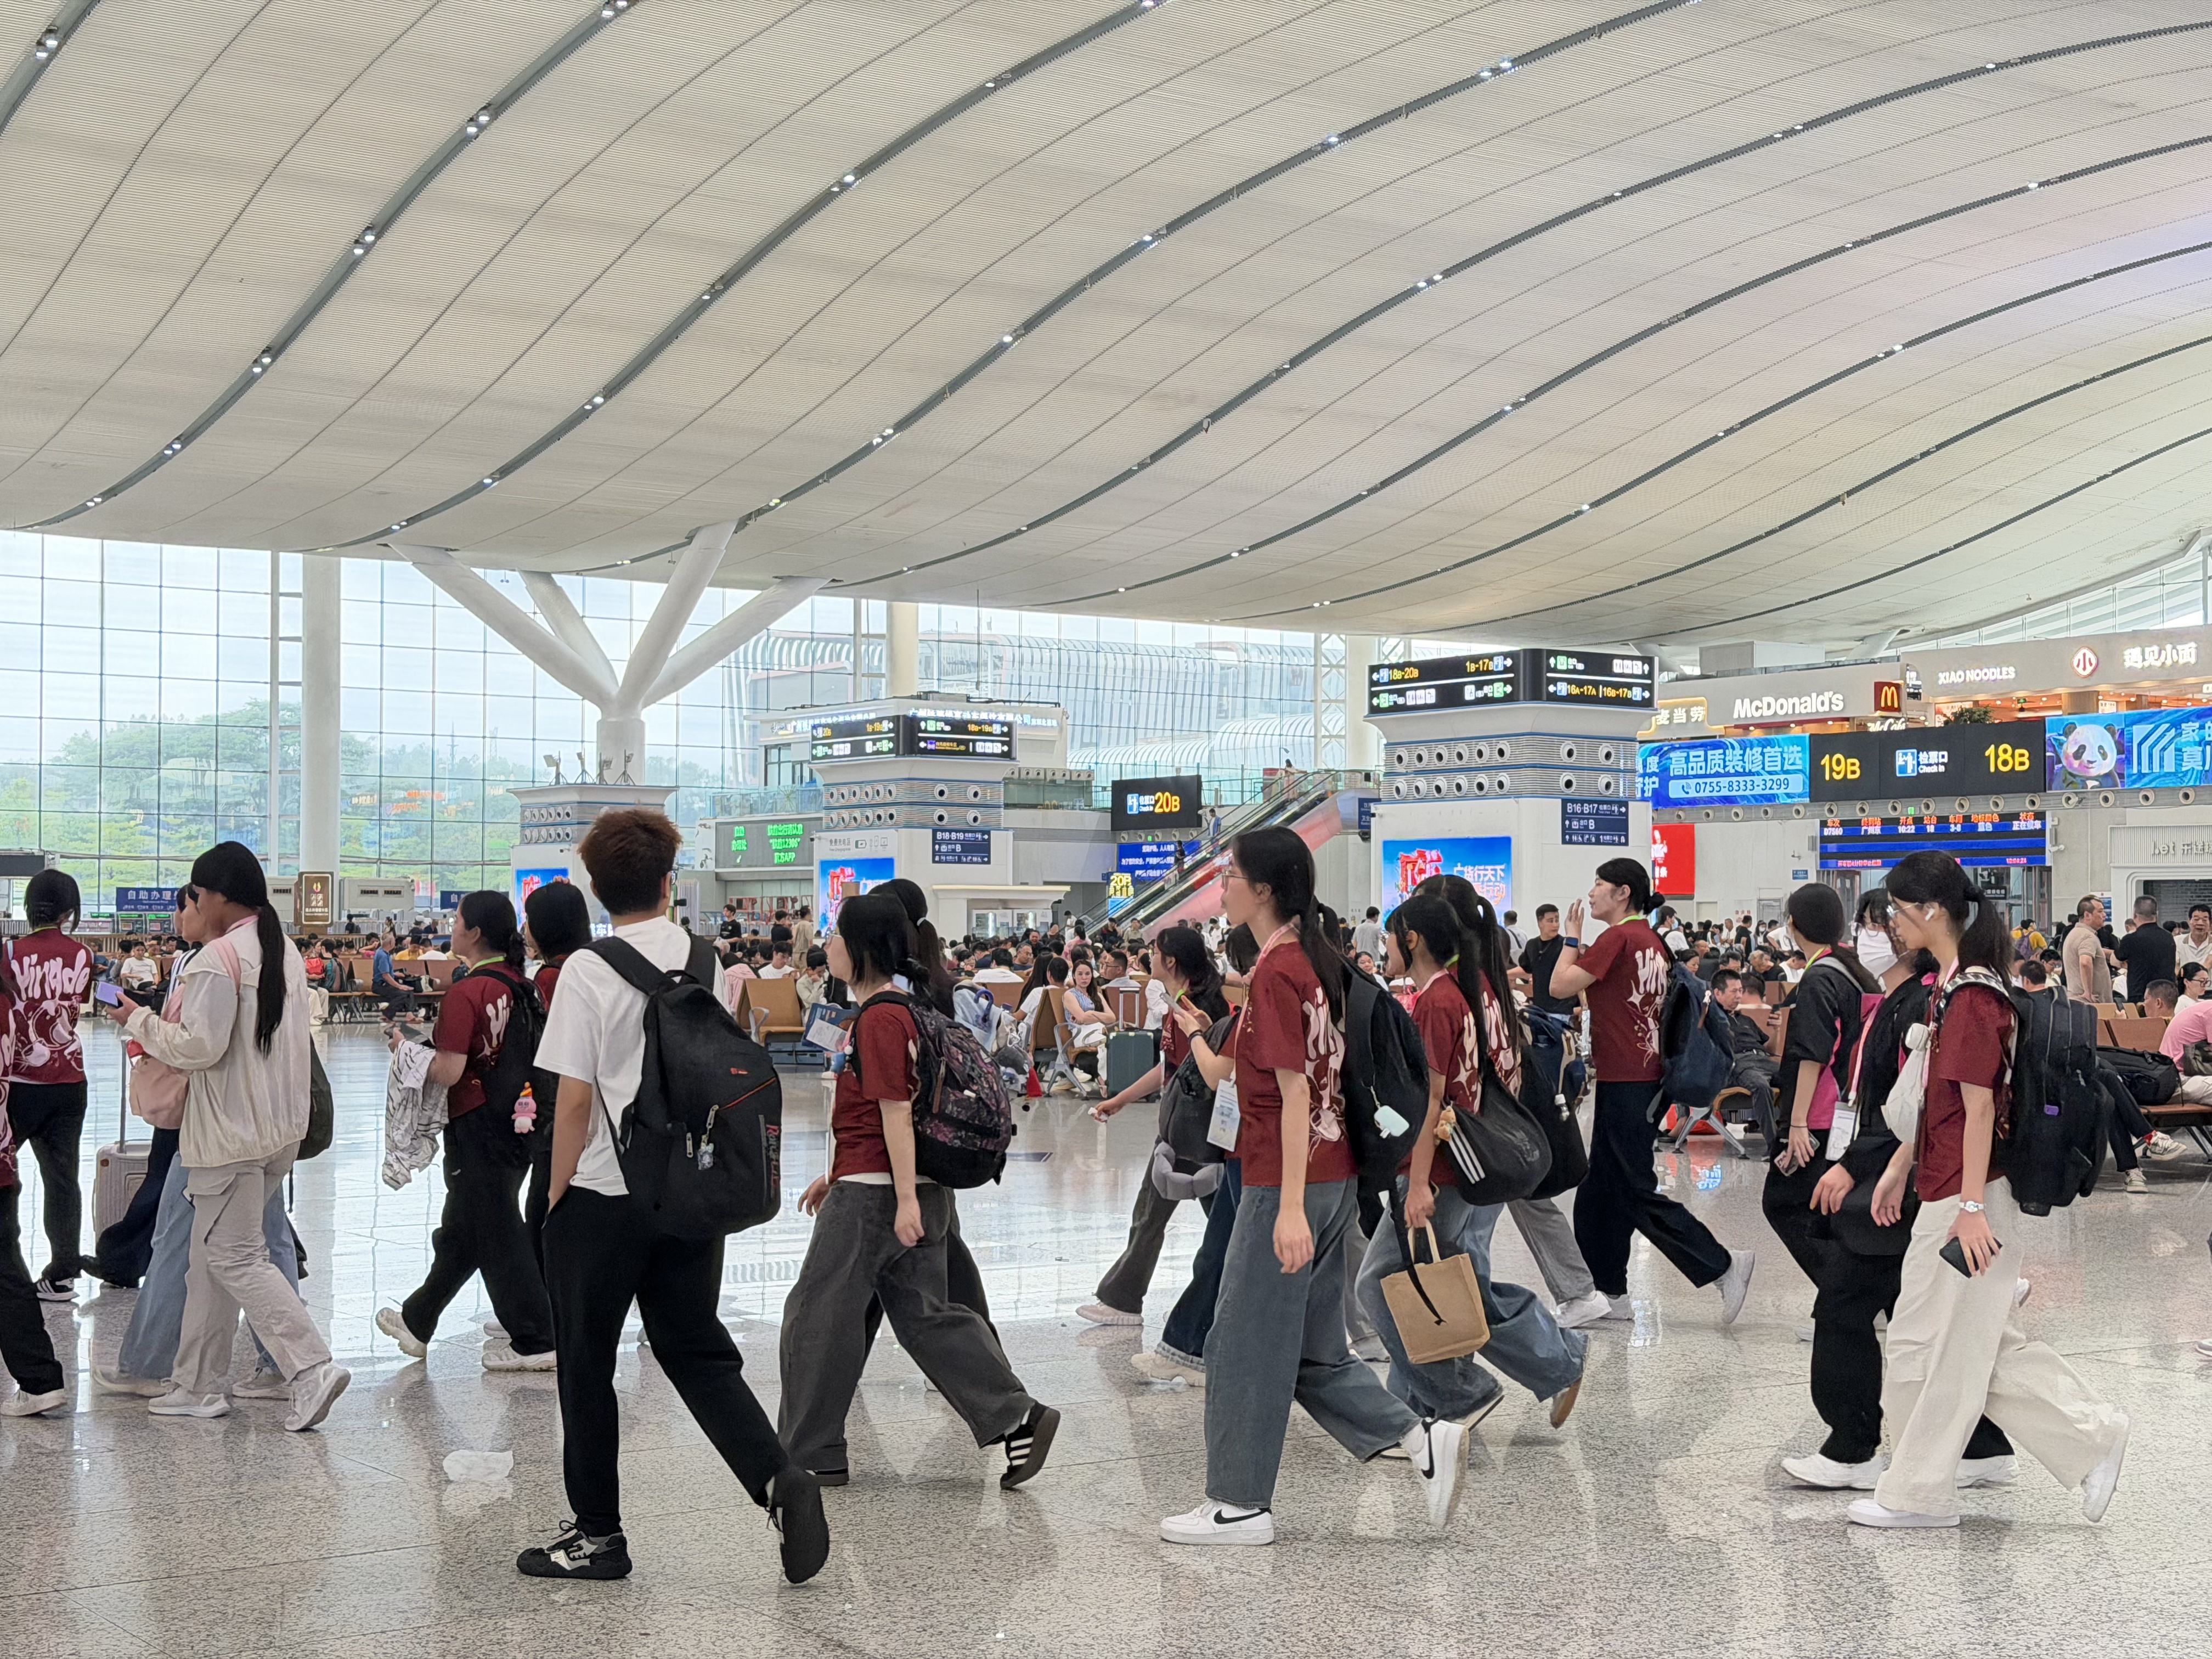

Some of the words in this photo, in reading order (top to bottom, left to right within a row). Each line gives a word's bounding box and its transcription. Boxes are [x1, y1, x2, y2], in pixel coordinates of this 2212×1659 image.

[2124, 641, 2198, 669] 遇见小面
[1389, 667, 1419, 680] 18B-20B
[1466, 659, 1493, 673] 1B-17B
[1938, 670, 1964, 685] XIAO
[1966, 667, 2016, 681] NOODLES
[1567, 684, 1596, 696] 16A-17A
[1603, 687, 1632, 699] 16B-17B
[1733, 691, 1844, 719] McDonald's
[1655, 706, 1706, 725] 麦当劳
[1669, 744, 1803, 777] 高品质装修首选
[1918, 751, 1948, 765] 检票口
[1984, 743, 2029, 773] 18B
[1820, 753, 1861, 781] 19B
[1695, 777, 1790, 794] 0755-8333-3299
[1154, 792, 1180, 812] 20B
[1589, 819, 1595, 830] B
[1898, 825, 1915, 833] 10:22
